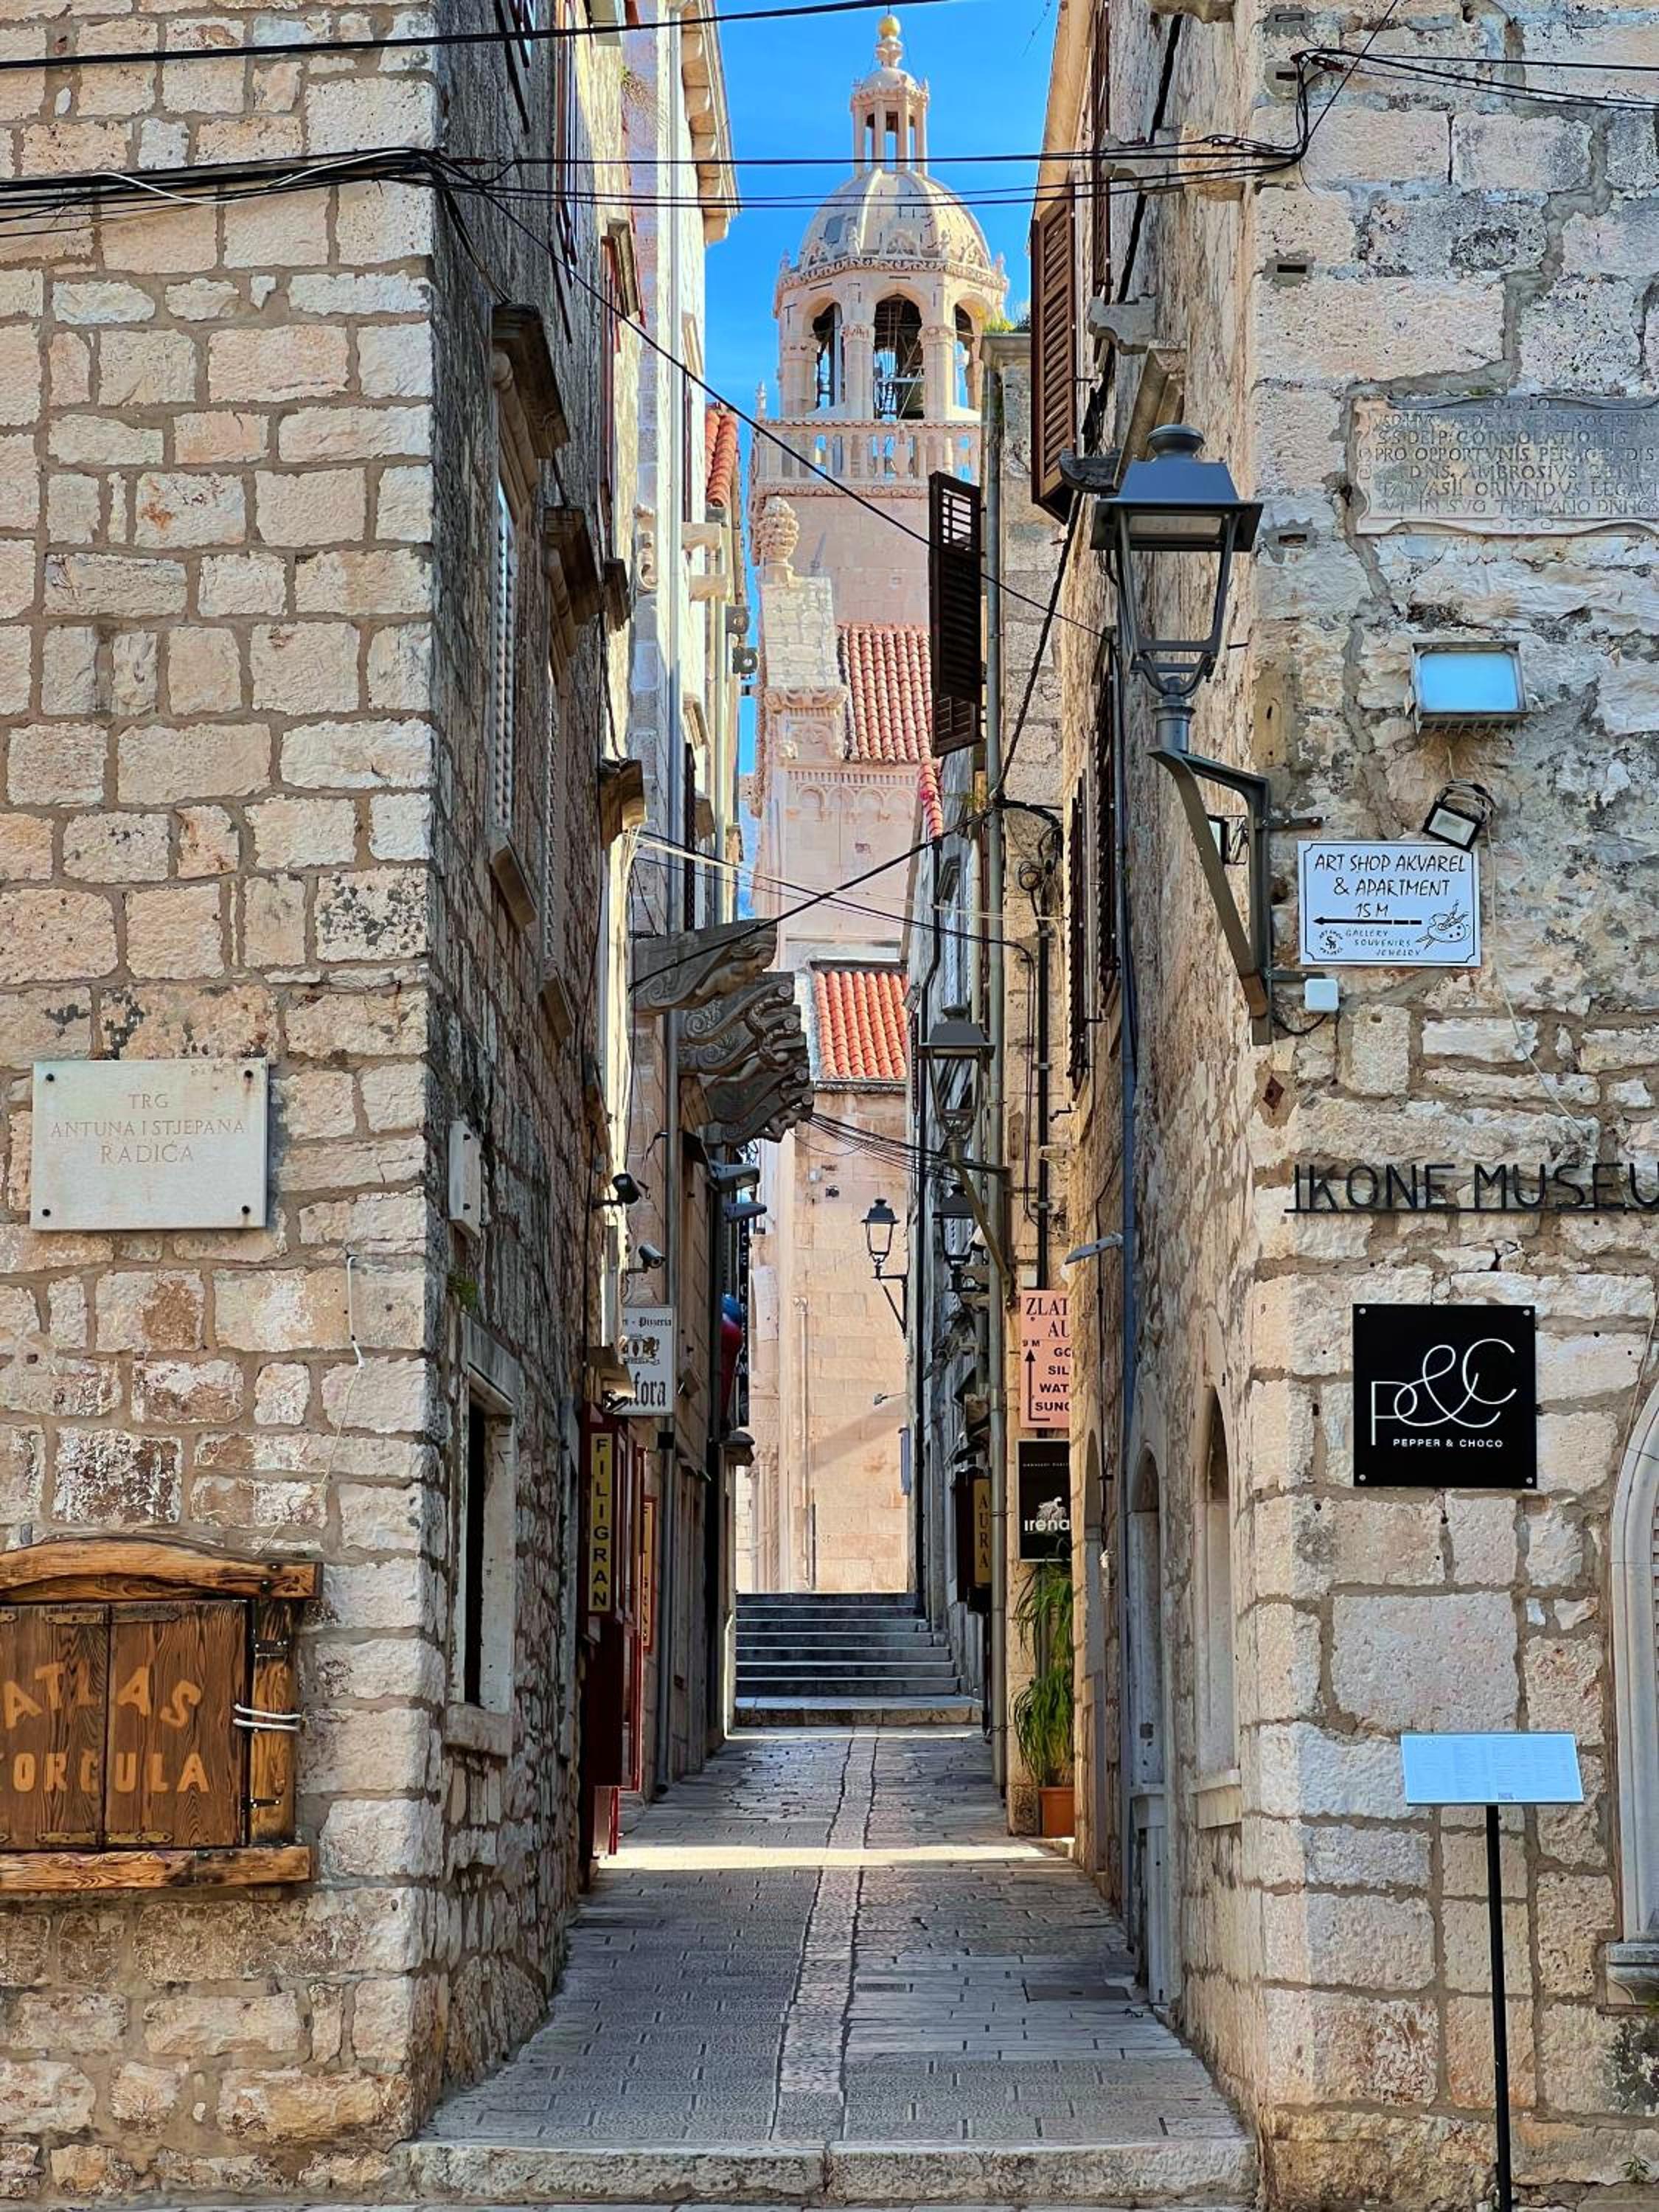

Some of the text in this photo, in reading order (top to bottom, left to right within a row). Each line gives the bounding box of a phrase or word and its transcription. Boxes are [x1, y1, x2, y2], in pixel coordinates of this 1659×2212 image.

[1375, 447, 1407, 462] PRO
[1313, 854, 1466, 872] ART SHOP AKVAREL
[1333, 877, 1450, 897] & APARTMENT
[1356, 902, 1388, 918] 15 M
[128, 1093, 168, 1109] TRG
[51, 1119, 245, 1138] ANTUNA I STJEPANA
[101, 1140, 195, 1164] RADIĆA
[1293, 1164, 1455, 1210] IKONE
[628, 1371, 667, 1407] fora
[1039, 1383, 1070, 1393] WAT
[1393, 1439, 1503, 1447] PEPPER & CHOCO
[593, 1438, 610, 1607] FILIGRAN
[978, 1492, 989, 1569] AURA
[3, 1659, 202, 1731] ATLAS
[0, 1747, 210, 1793] ORČULA
